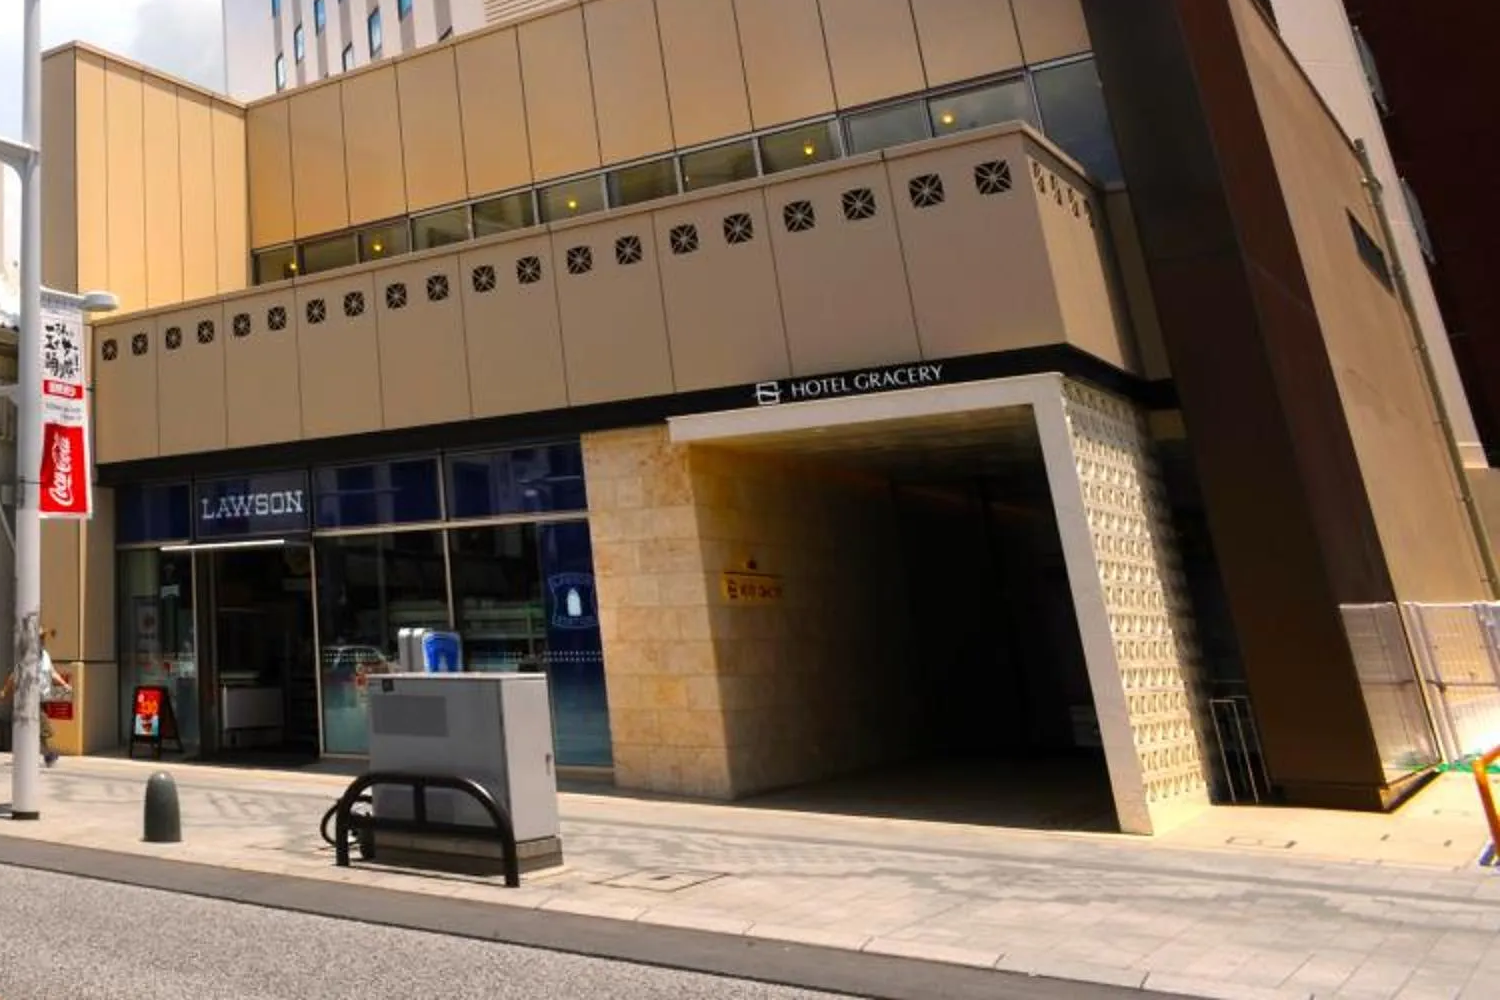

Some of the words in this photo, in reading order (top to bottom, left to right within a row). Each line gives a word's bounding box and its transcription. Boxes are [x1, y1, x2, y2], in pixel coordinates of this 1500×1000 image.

[791, 376, 850, 398] HOTEL
[853, 364, 943, 390] GRACERY
[201, 489, 303, 521] LAWSON
